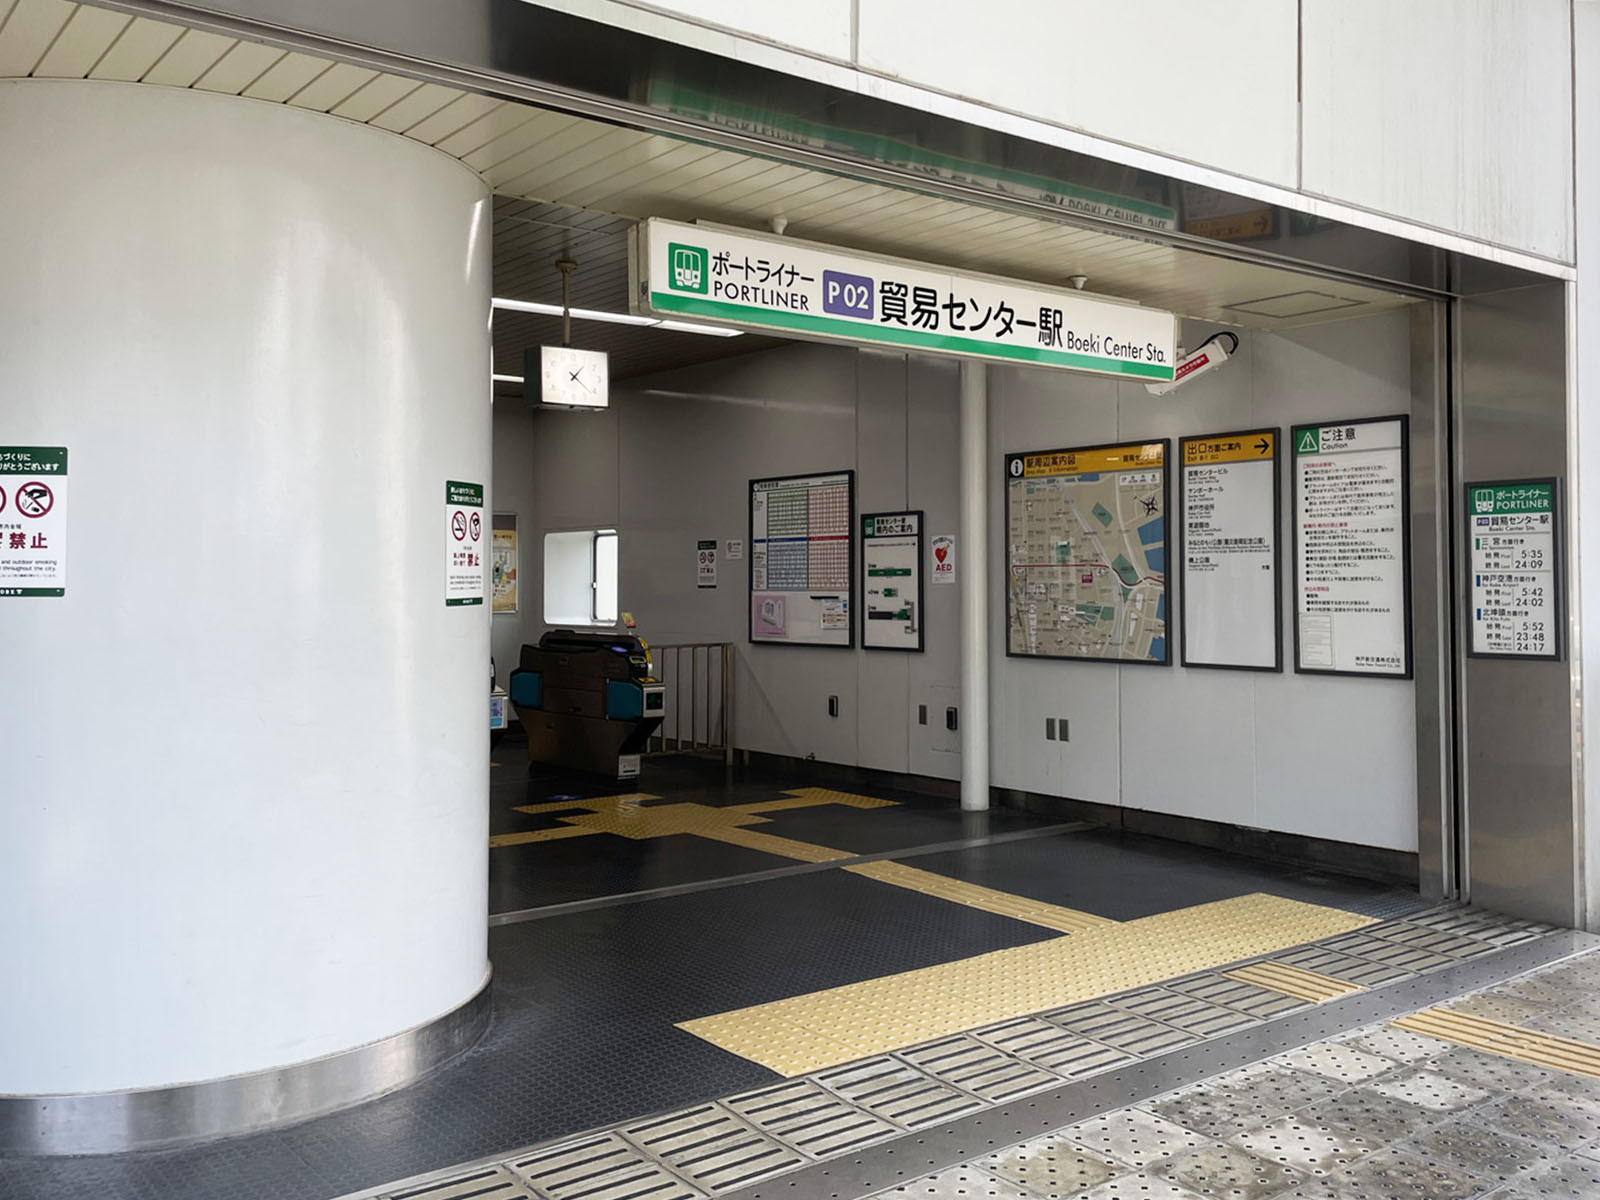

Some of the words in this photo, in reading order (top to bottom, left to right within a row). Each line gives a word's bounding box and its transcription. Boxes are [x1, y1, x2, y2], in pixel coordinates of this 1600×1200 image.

[712, 251, 815, 287] ポートライナー
[714, 281, 809, 311] PORTLINER
[879, 281, 1064, 348] 貿易センター駅
[1067, 331, 1100, 354] Boeki
[1104, 337, 1143, 361] Center
[1146, 343, 1166, 364] Sta.
[1322, 427, 1356, 442] ご注意
[1496, 489, 1549, 500] ポートライナー
[1496, 500, 1549, 510] PORTLINER
[1492, 514, 1549, 526] 貿易センター駅
[9, 532, 48, 549] 禁止
[1522, 550, 1543, 558] 5:35
[936, 564, 952, 572] AED
[1515, 560, 1543, 568] 24:09
[1522, 588, 1544, 596] 5:42
[1516, 598, 1544, 606] 24:02
[1522, 622, 1544, 630] 5:52
[1516, 632, 1544, 641] 23:48
[1516, 643, 1544, 651] 24:17
